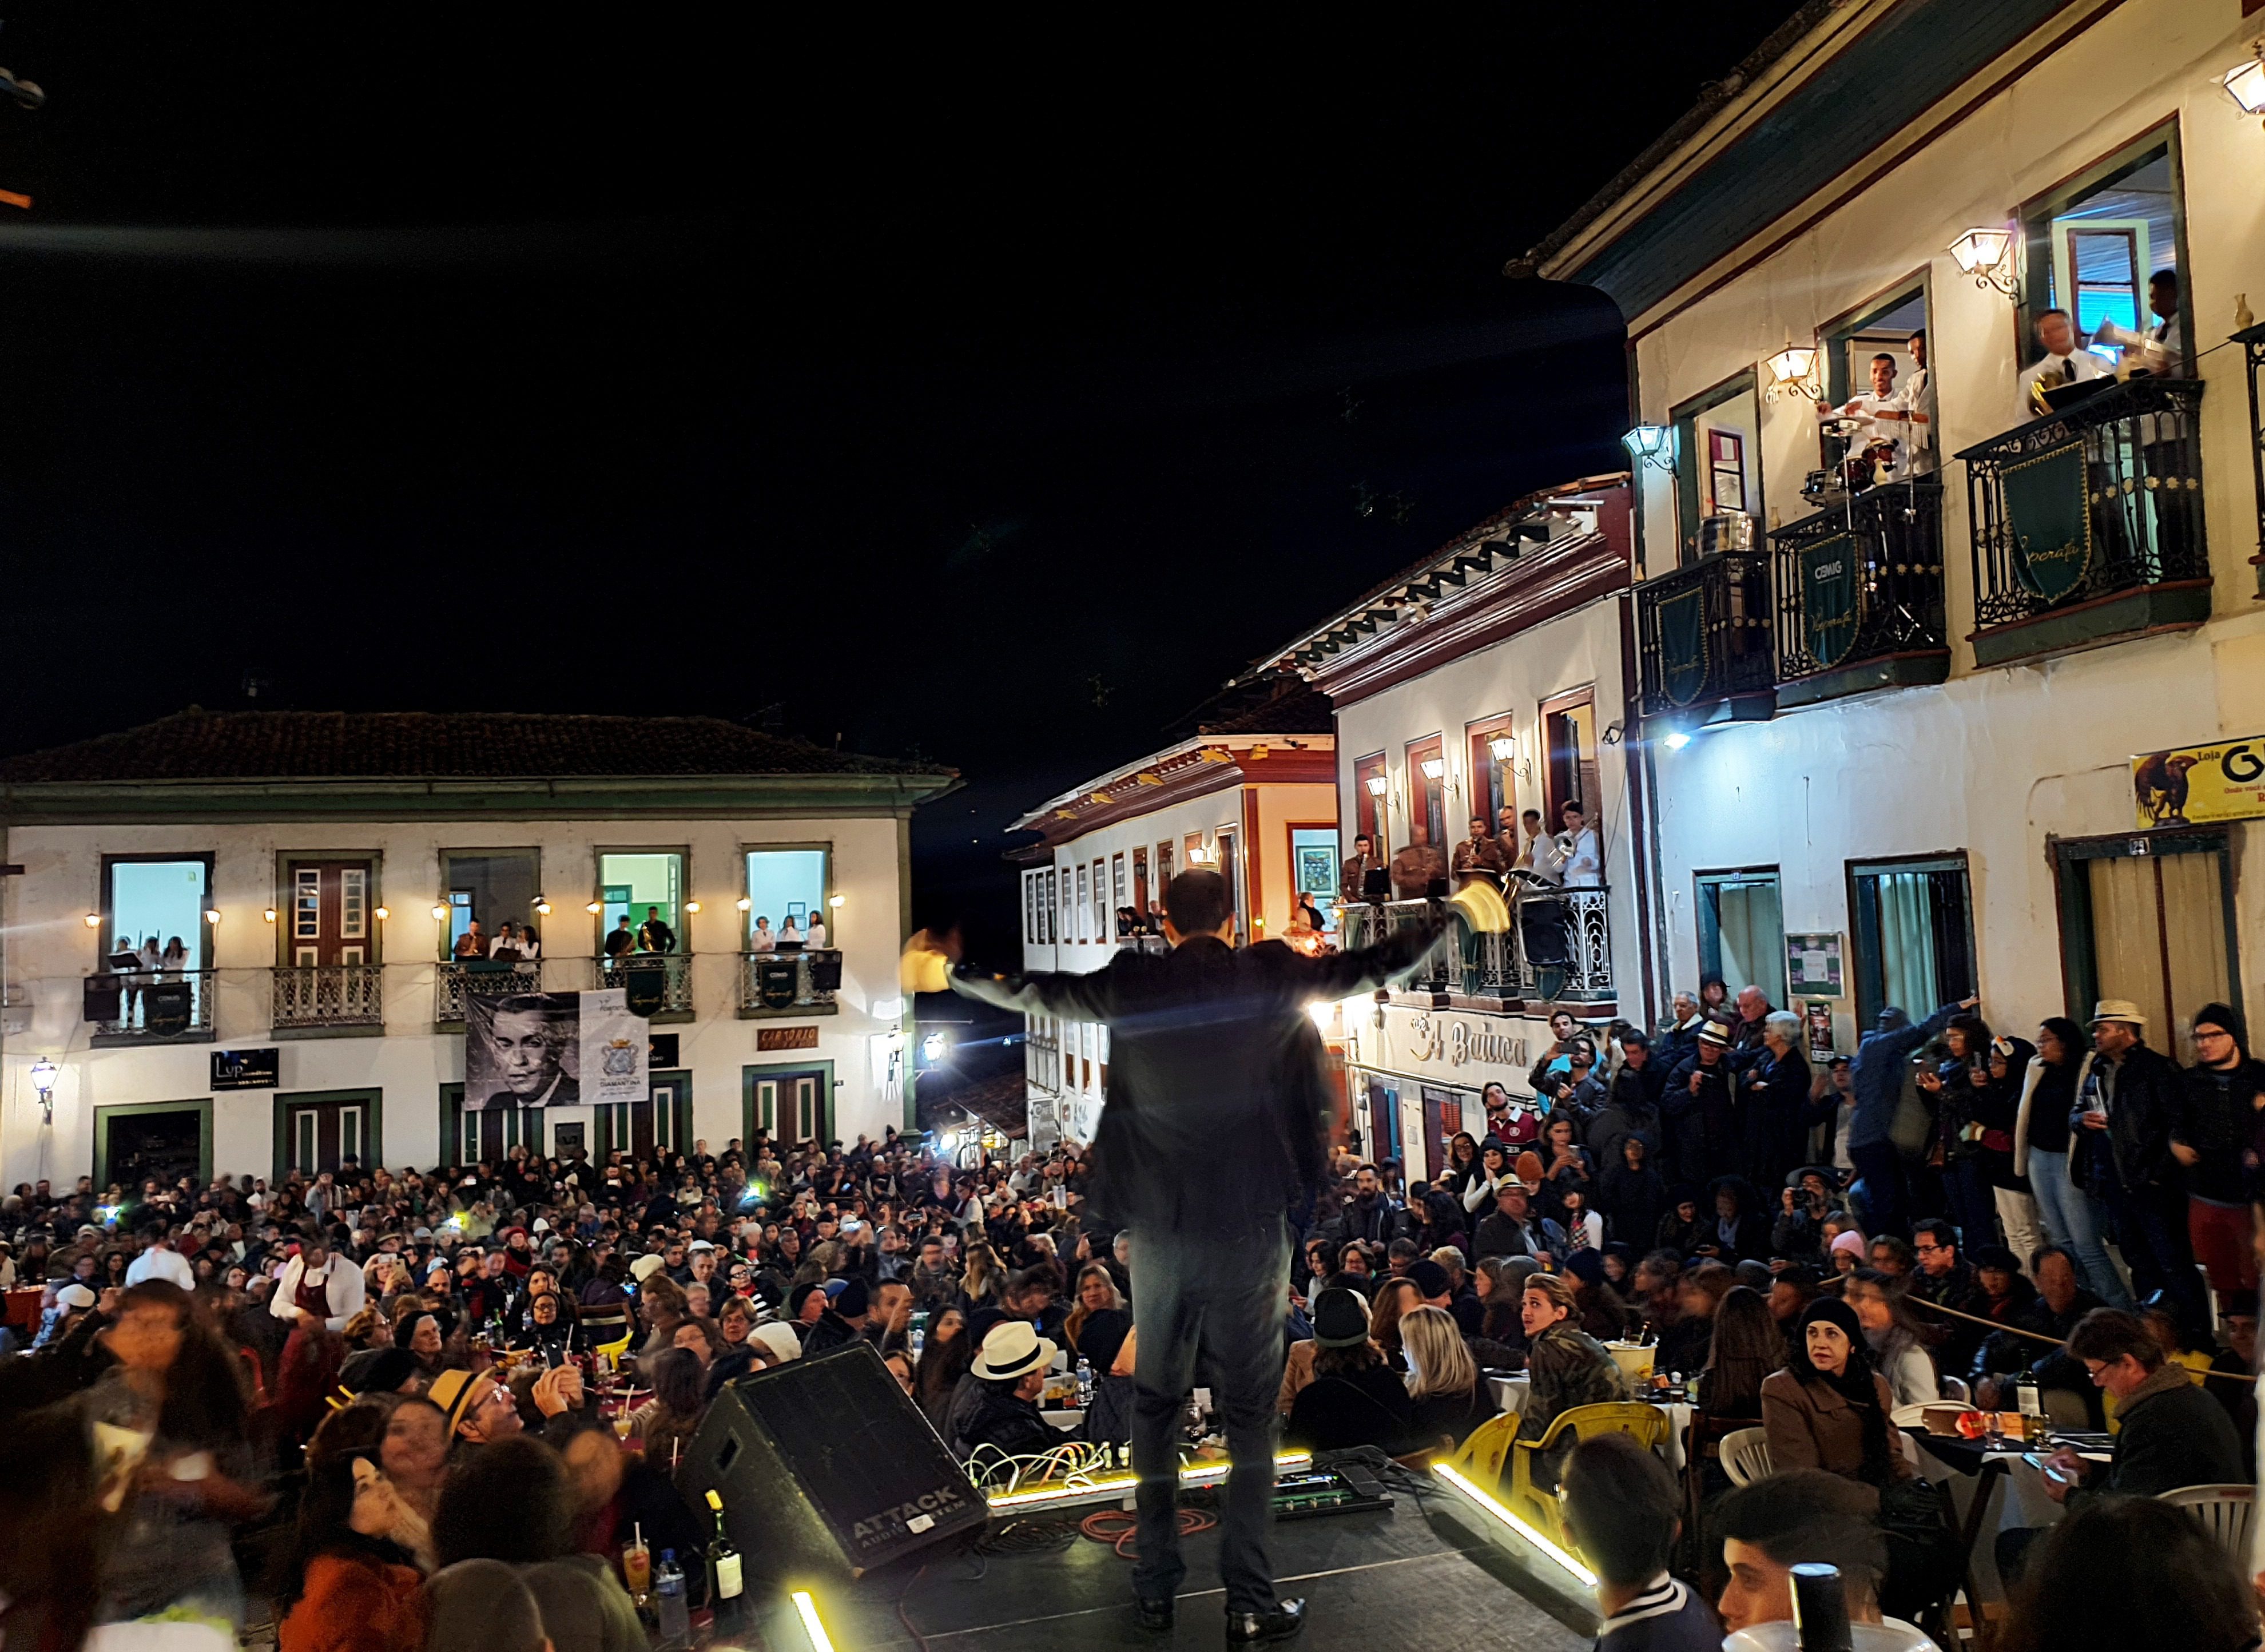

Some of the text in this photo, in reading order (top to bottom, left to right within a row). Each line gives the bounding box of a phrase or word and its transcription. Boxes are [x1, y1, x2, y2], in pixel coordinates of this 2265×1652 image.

[1814, 560, 1843, 579] CEMIG
[2197, 745, 2265, 783] Loja G
[1451, 1021, 1526, 1067] Baiuca
[216, 1057, 243, 1078] Lup
[854, 1486, 958, 1539] ATTACK
